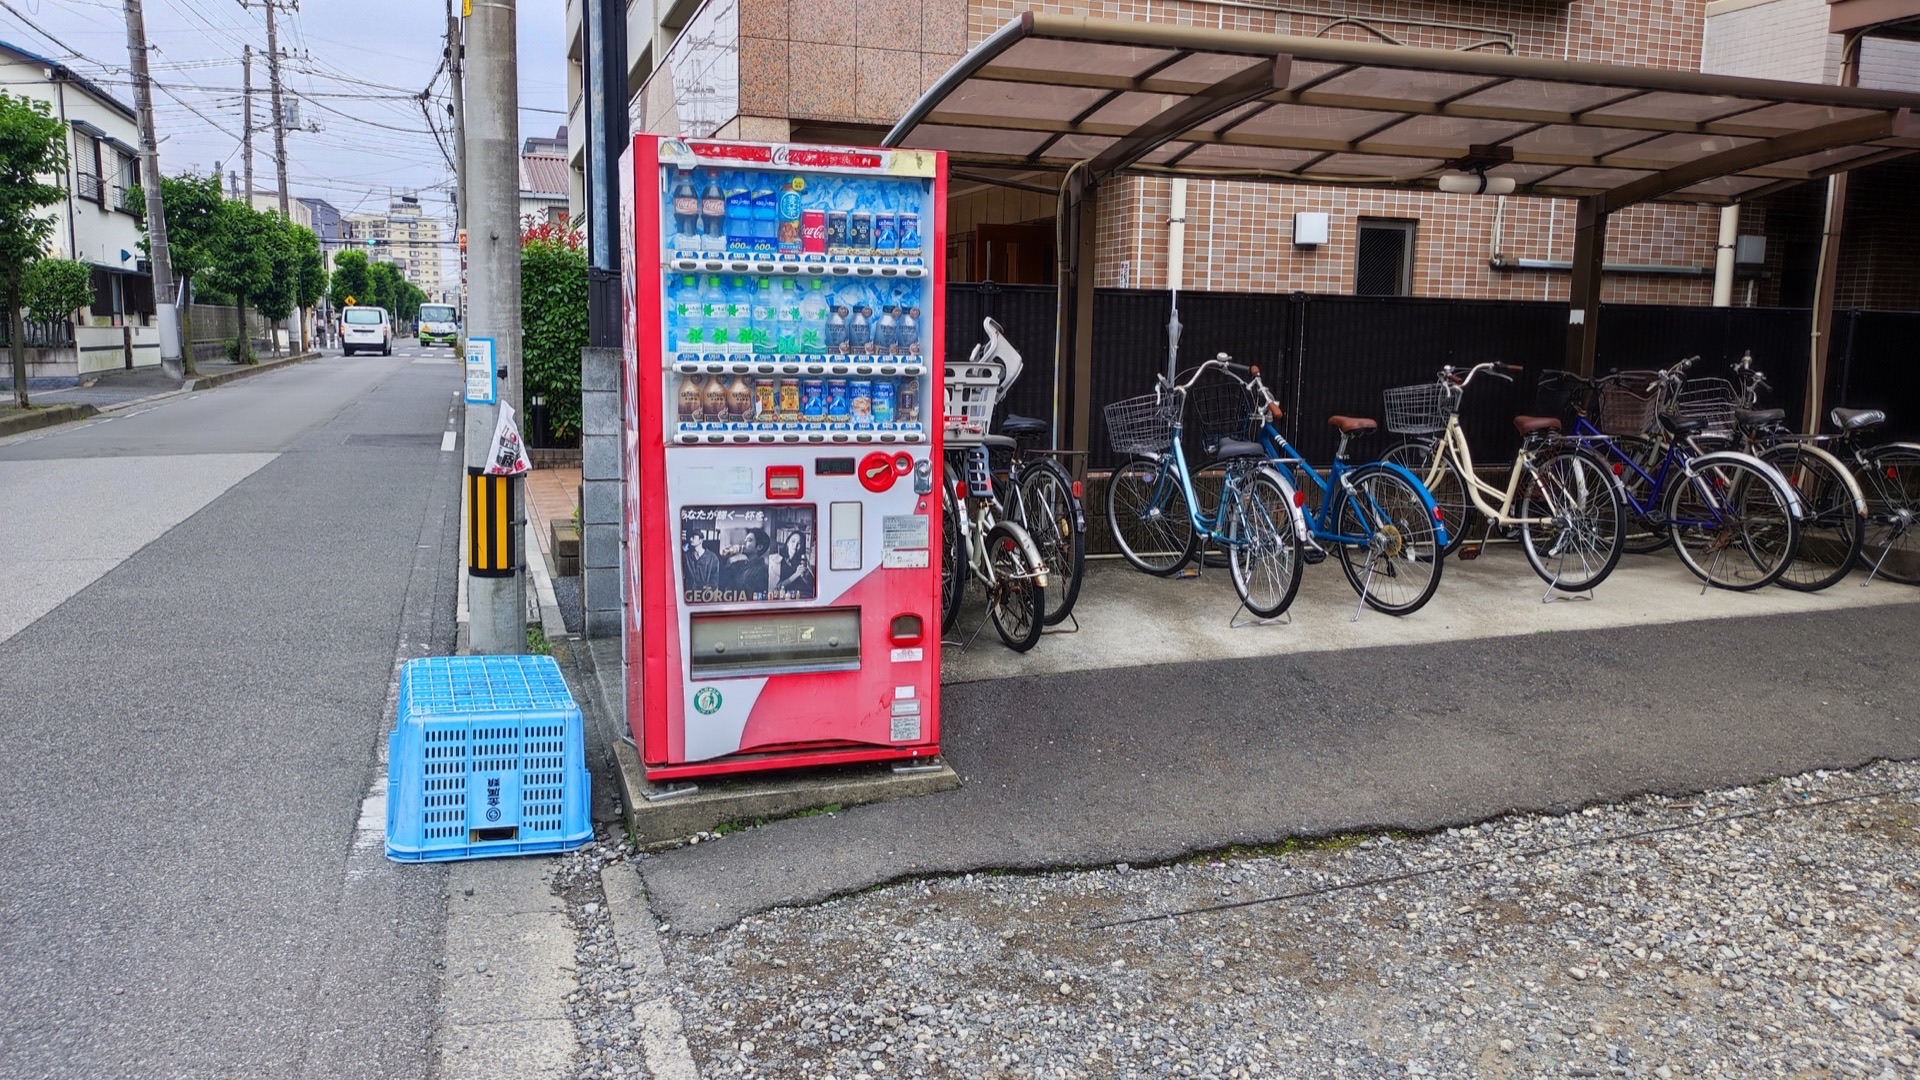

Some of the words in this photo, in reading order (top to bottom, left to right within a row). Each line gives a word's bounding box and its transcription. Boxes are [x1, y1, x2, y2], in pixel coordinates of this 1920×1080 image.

[787, 195, 797, 216] 麦茶
[681, 509, 768, 522] あなたが輝く一杯を。
[685, 588, 747, 602] GEORGIA
[487, 778, 500, 807] 金属類
